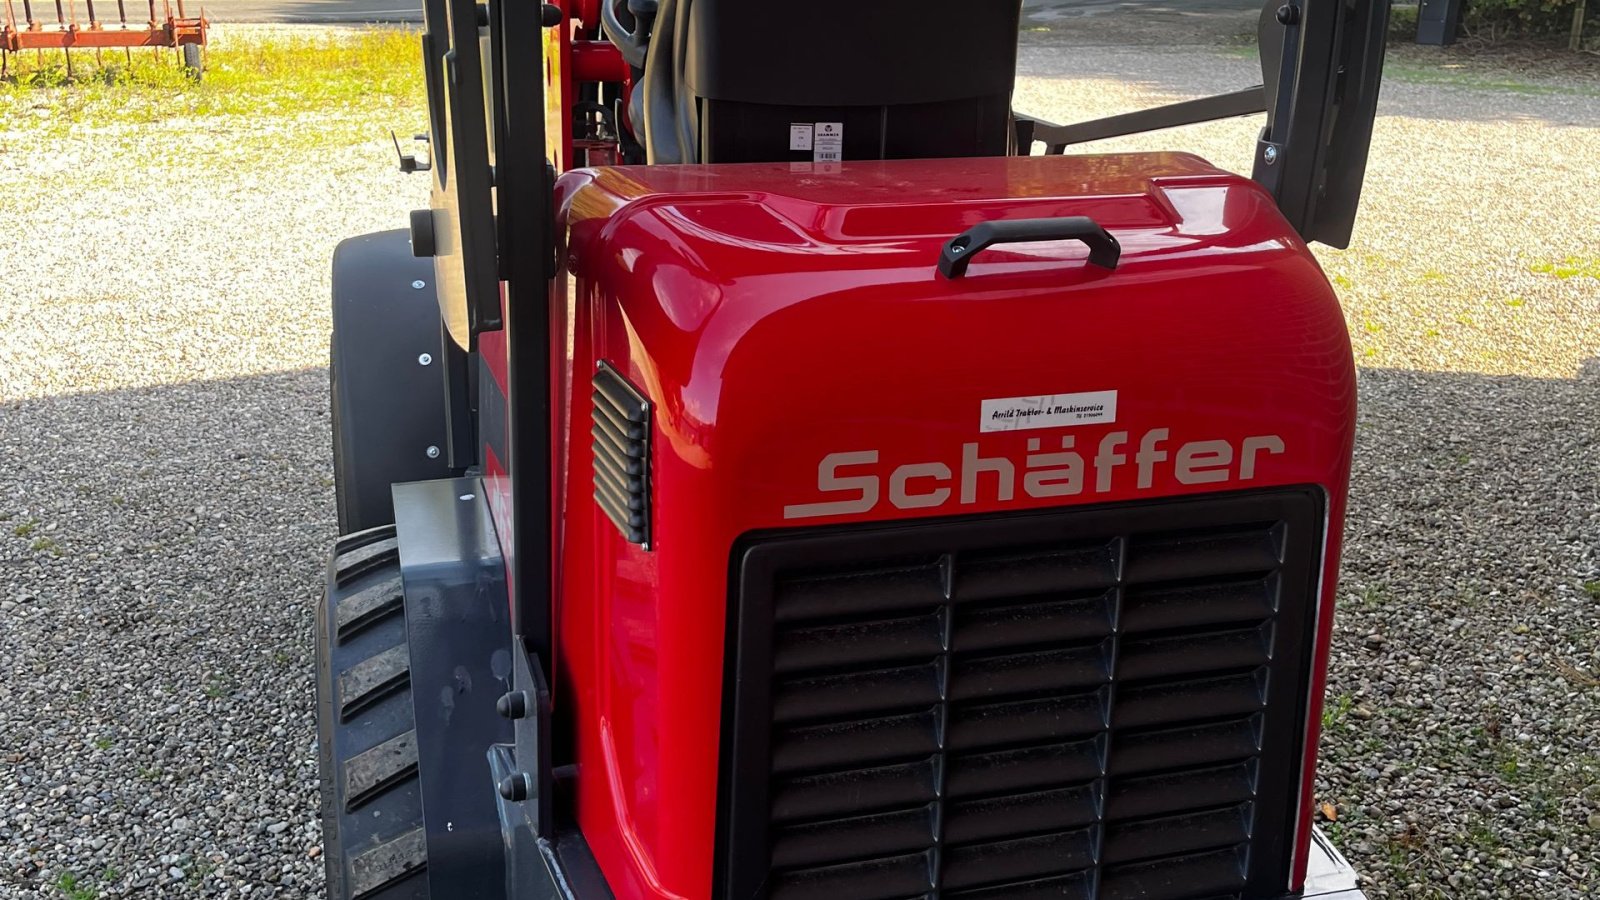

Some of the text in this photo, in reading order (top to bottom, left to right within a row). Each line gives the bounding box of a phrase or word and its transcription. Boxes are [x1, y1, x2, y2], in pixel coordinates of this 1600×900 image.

[1016, 408, 1044, 417] Traktor-
[1046, 407, 1052, 415] &
[1054, 404, 1104, 414] Maskinservice
[784, 428, 1285, 518] Schäffer
